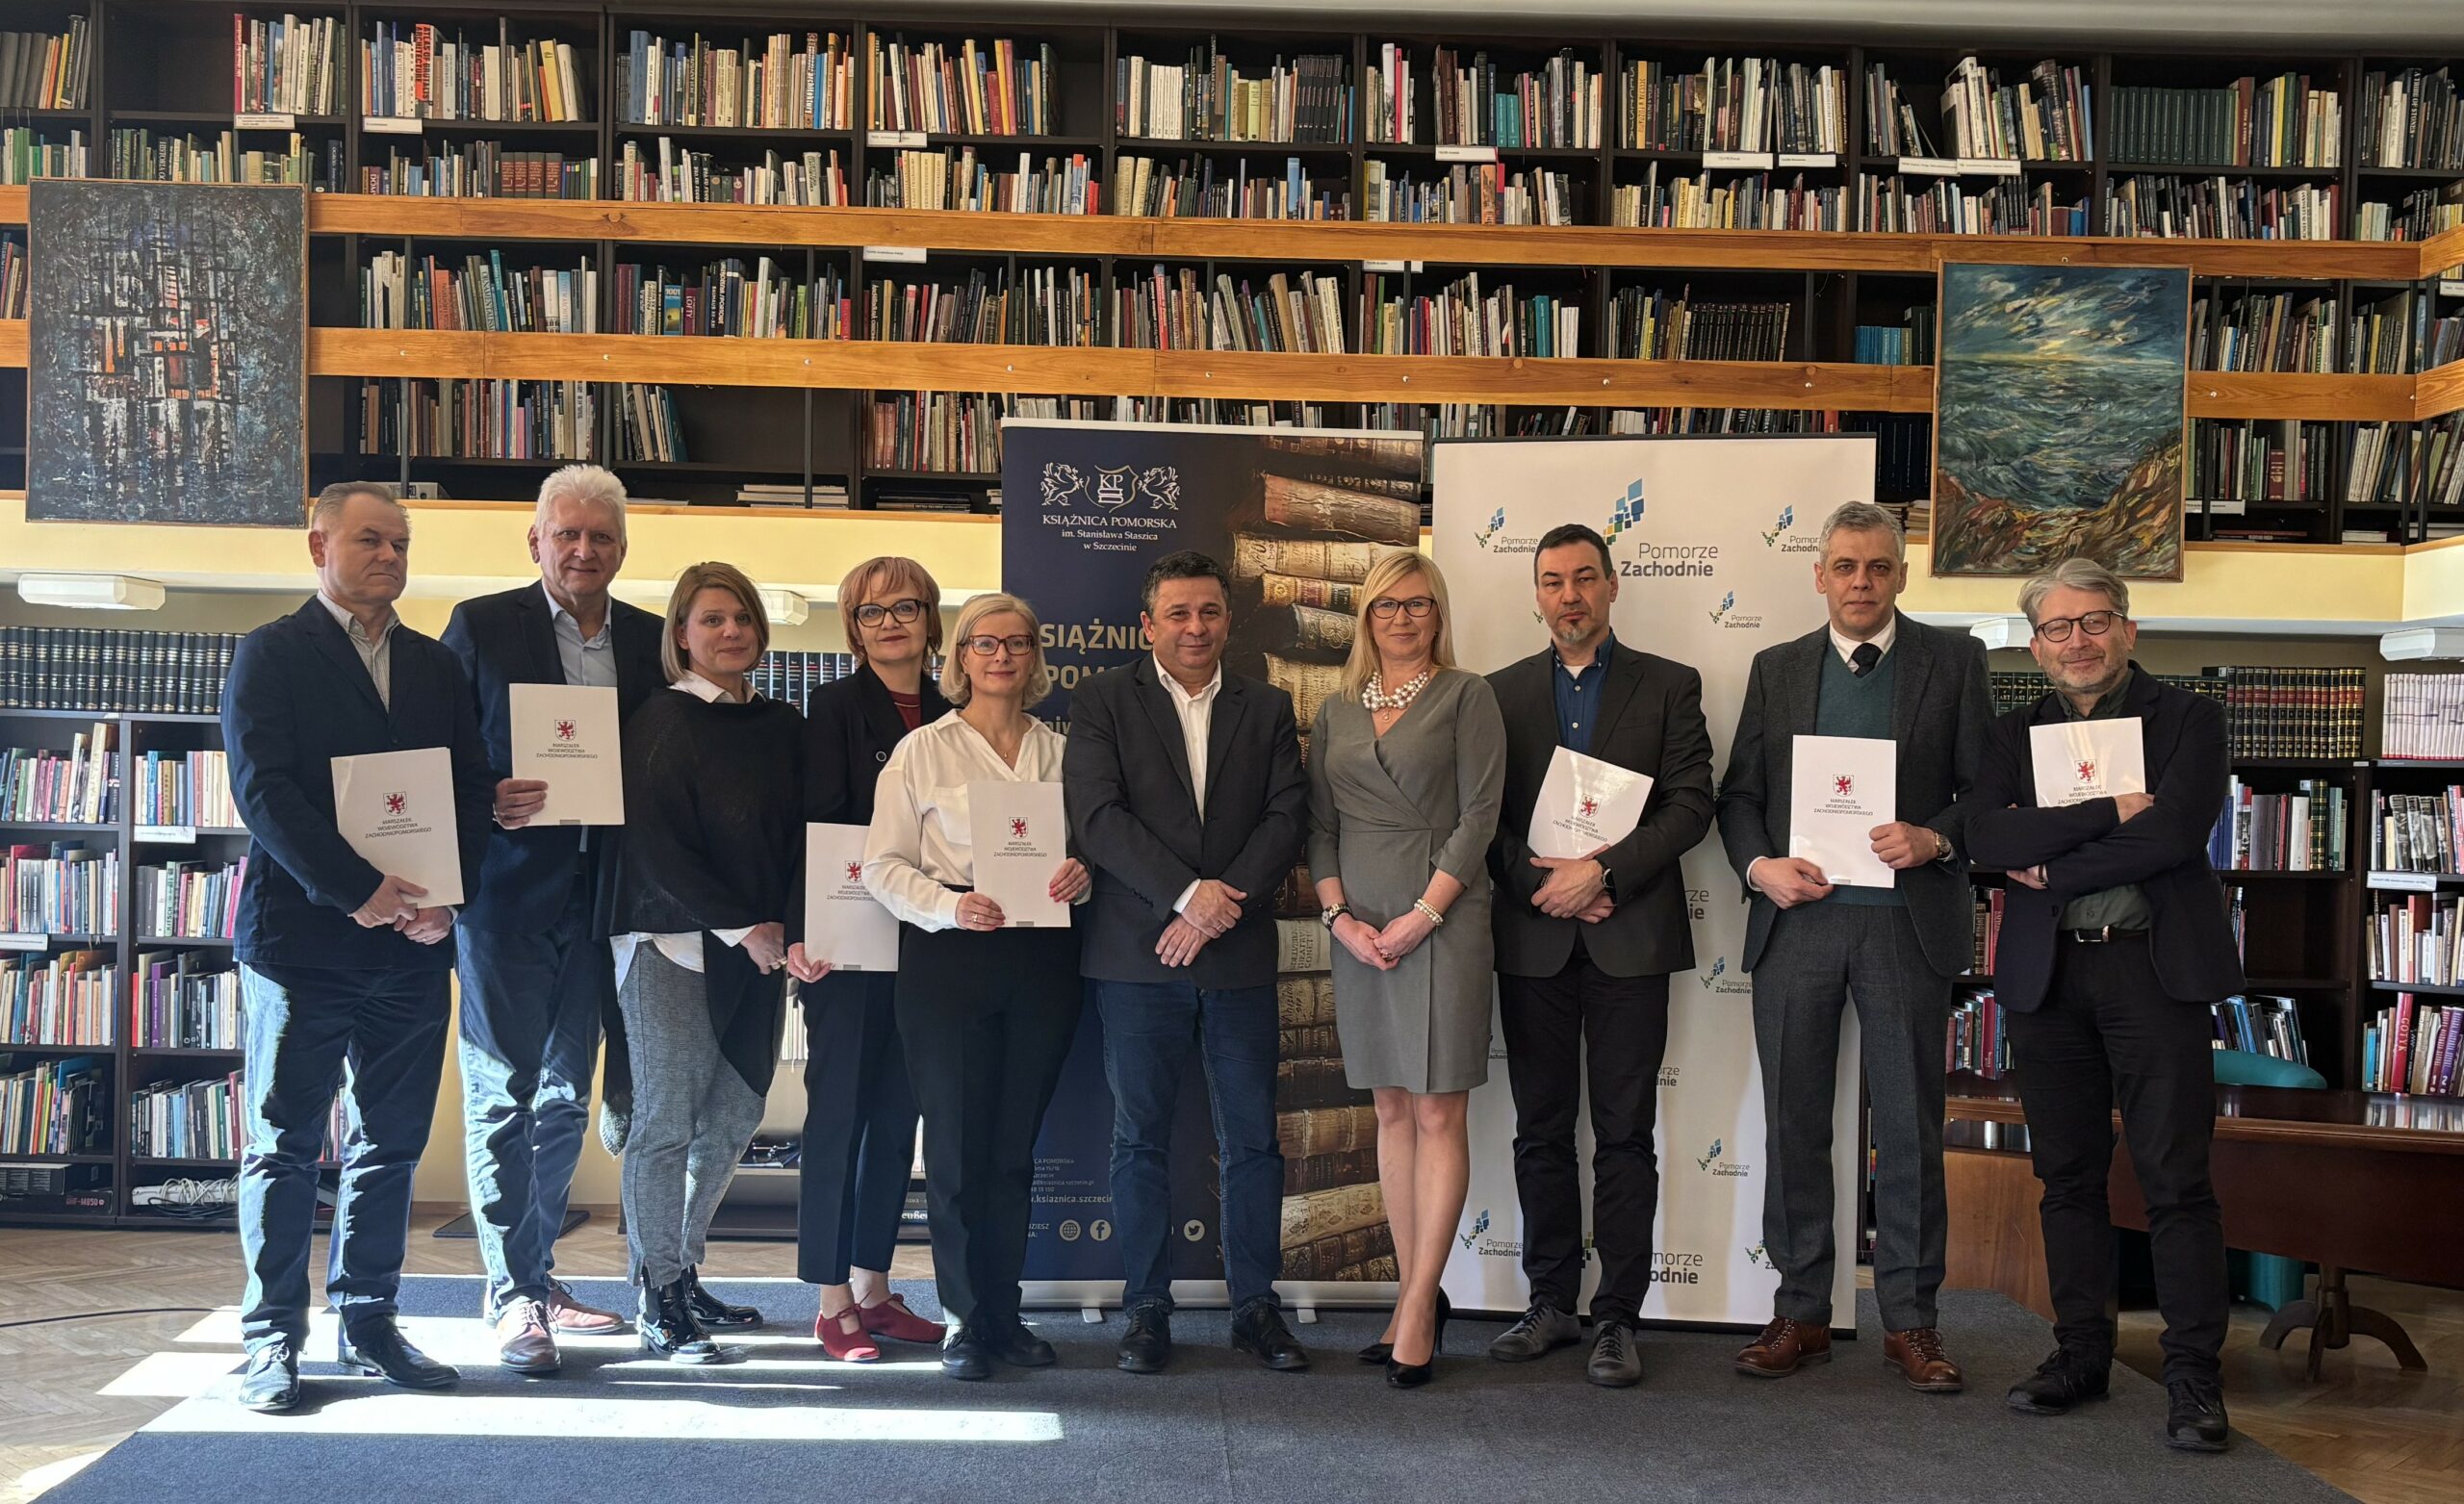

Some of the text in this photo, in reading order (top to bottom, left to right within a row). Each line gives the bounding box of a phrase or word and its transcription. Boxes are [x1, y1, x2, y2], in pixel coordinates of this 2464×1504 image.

[1099, 473, 1123, 489] KP
[1042, 513, 1177, 528] KSIĄŻNICA POMORSKA
[1062, 529, 1158, 541] im. Stanisława Staszica
[1502, 536, 1538, 545] Pomorze
[1790, 535, 1821, 544] Pomor
[1093, 542, 1137, 551] Szczecinie
[1493, 545, 1536, 553] Zachodnie
[1639, 543, 1718, 559] Pomorze
[1781, 544, 1820, 552] Zachodn
[1621, 560, 1713, 576] Zachodnie
[2398, 1017, 2409, 1052] GOTYK
[1718, 1162, 1750, 1171] Pomorze
[1712, 1169, 1748, 1178] Zachodnie
[1486, 1238, 1524, 1249] Pomorze
[1478, 1247, 1522, 1258] Zachodnie
[1653, 1252, 1704, 1267] morze
[1650, 1268, 1699, 1285] odnie
